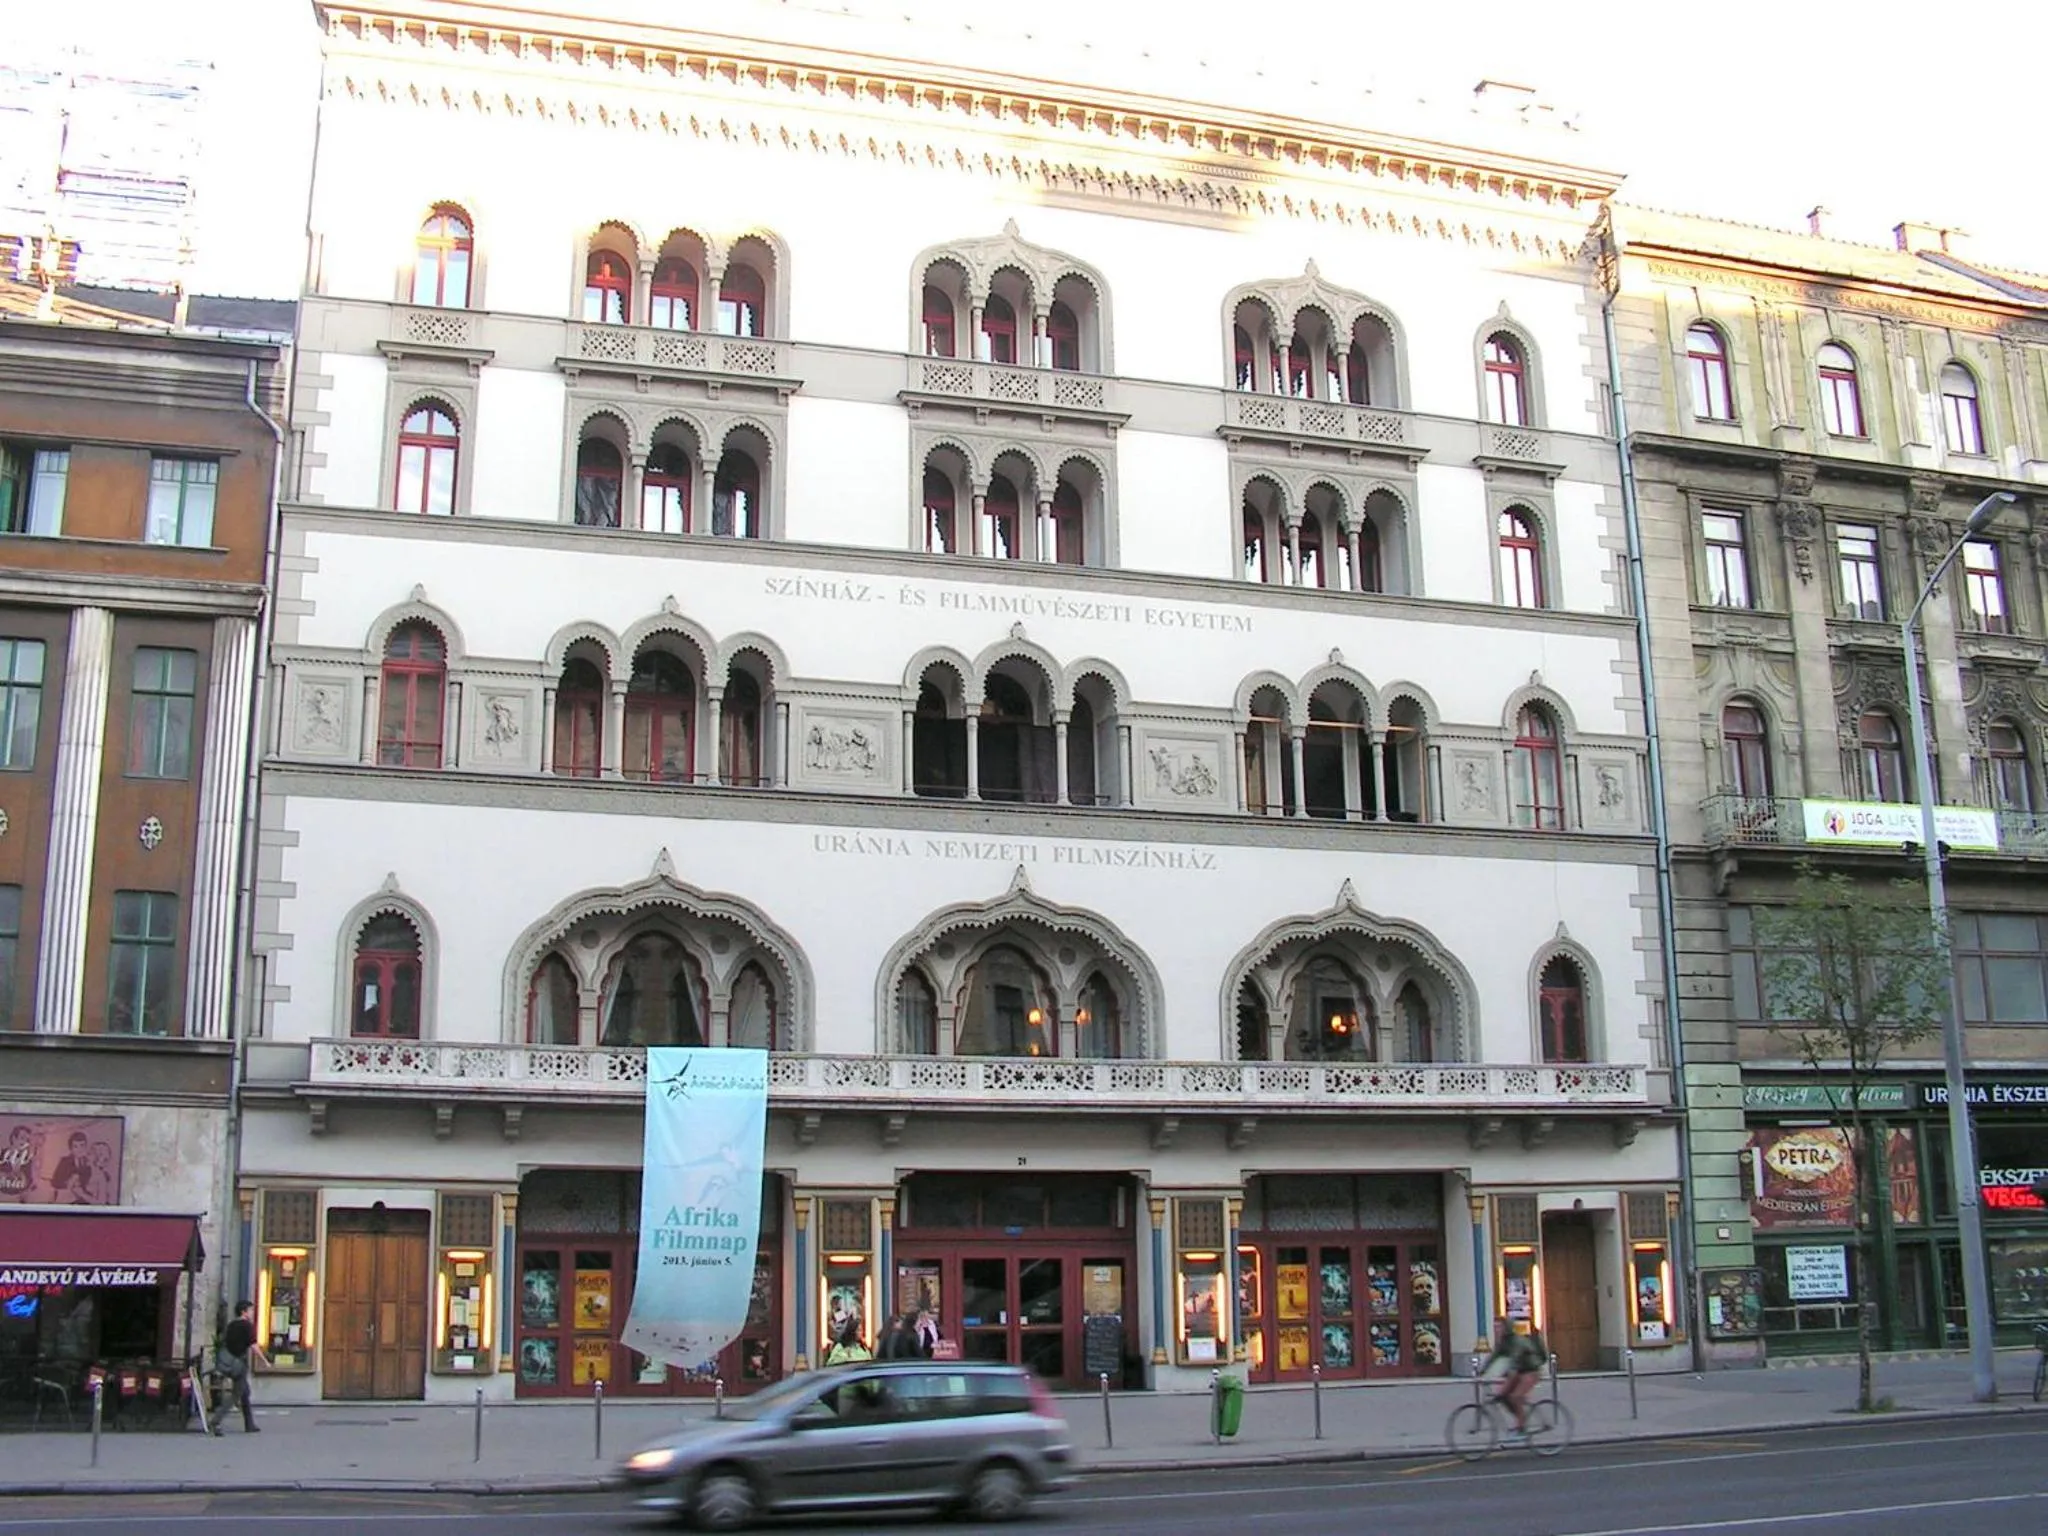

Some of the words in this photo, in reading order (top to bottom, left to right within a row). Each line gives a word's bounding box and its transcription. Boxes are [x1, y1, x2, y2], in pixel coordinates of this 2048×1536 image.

[899, 584, 926, 606] ÉS
[1144, 607, 1254, 633] EGYETEM
[813, 831, 911, 857] URÁNIA
[925, 840, 1038, 863] NEMZETI
[1053, 846, 1218, 871] FILMSZÍNHÁZ
[1924, 1086, 1989, 1103] URNIA
[1992, 1083, 2048, 1103] ÉKSZE
[1778, 1148, 1834, 1166] PETRA
[1980, 1164, 2048, 1186] ÉKSZE
[663, 1205, 739, 1228] Afrika
[652, 1228, 748, 1256] Filmnap
[662, 1255, 688, 1266] 2013.
[75, 1267, 159, 1285] KÁVÉHÁZ
